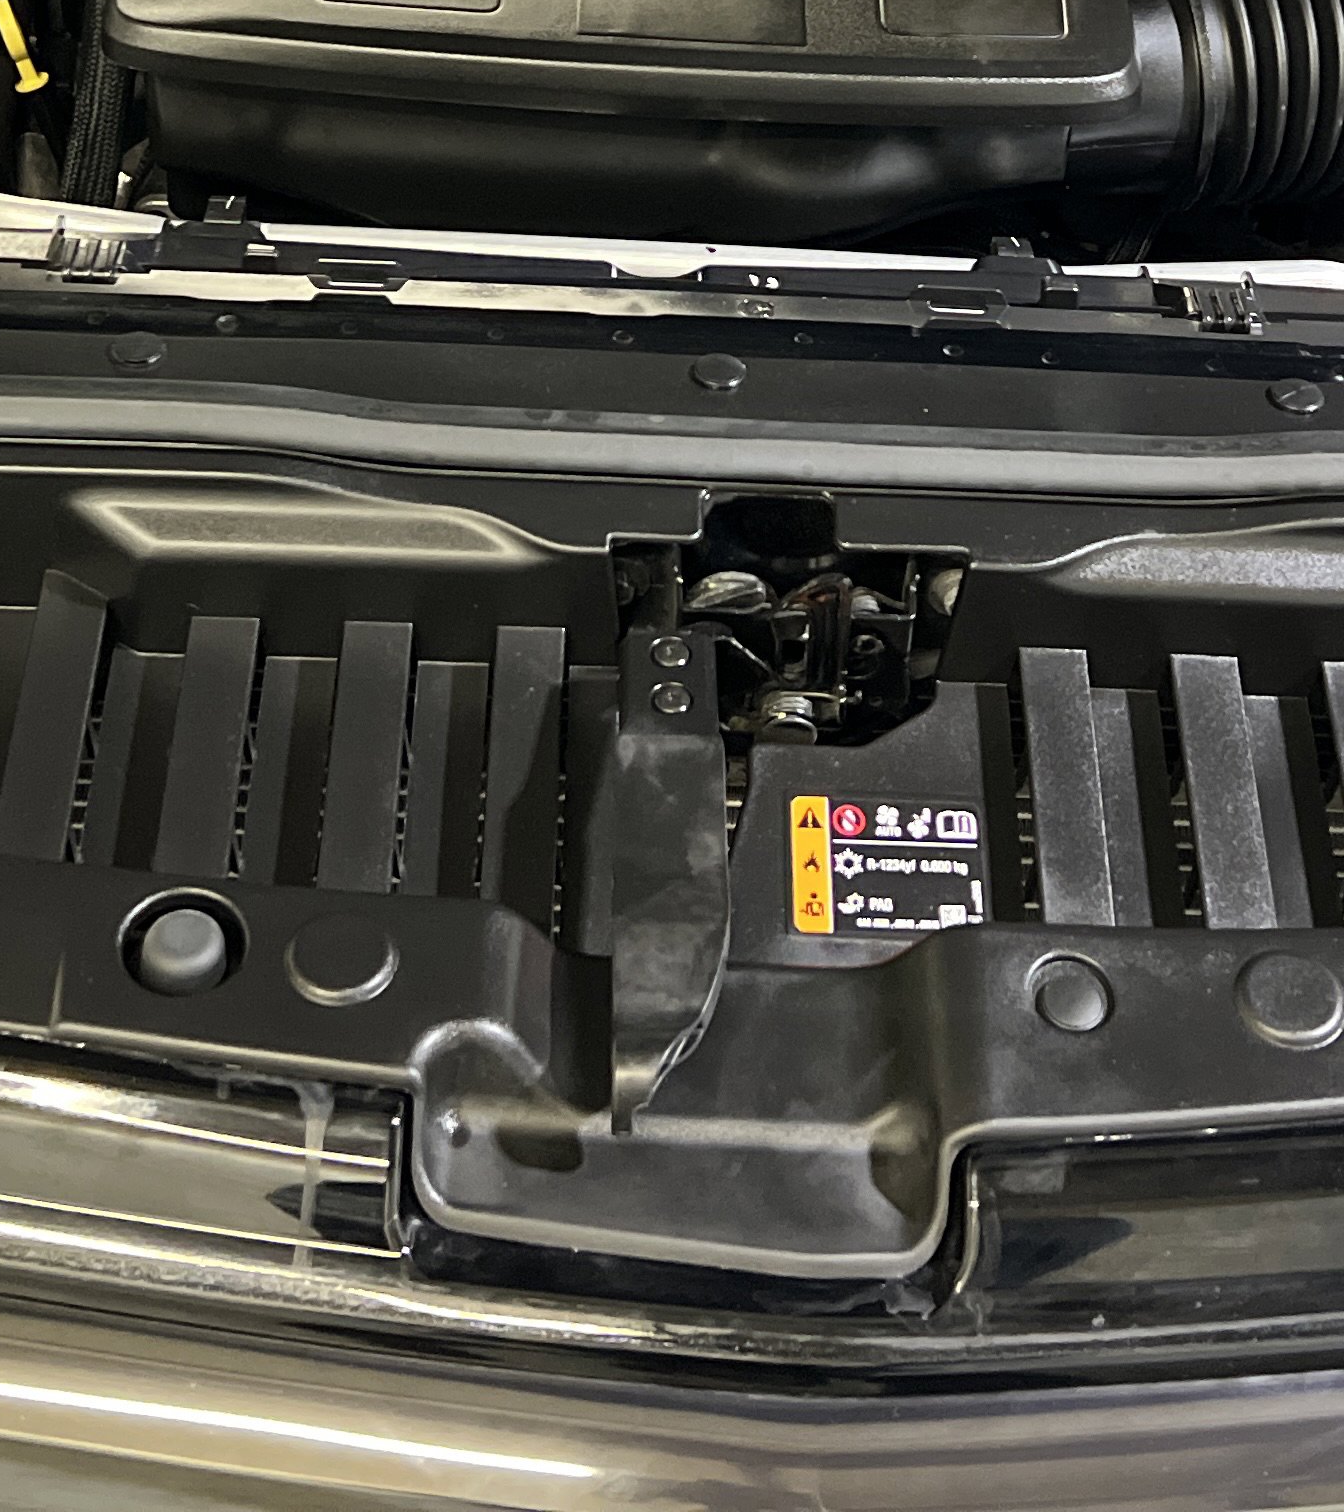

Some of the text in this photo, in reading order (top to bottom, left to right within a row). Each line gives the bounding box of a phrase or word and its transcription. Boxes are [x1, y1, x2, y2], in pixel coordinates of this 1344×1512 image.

[875, 825, 901, 837] AUTO
[867, 858, 916, 874] R-1234yf
[953, 861, 968, 876] kg
